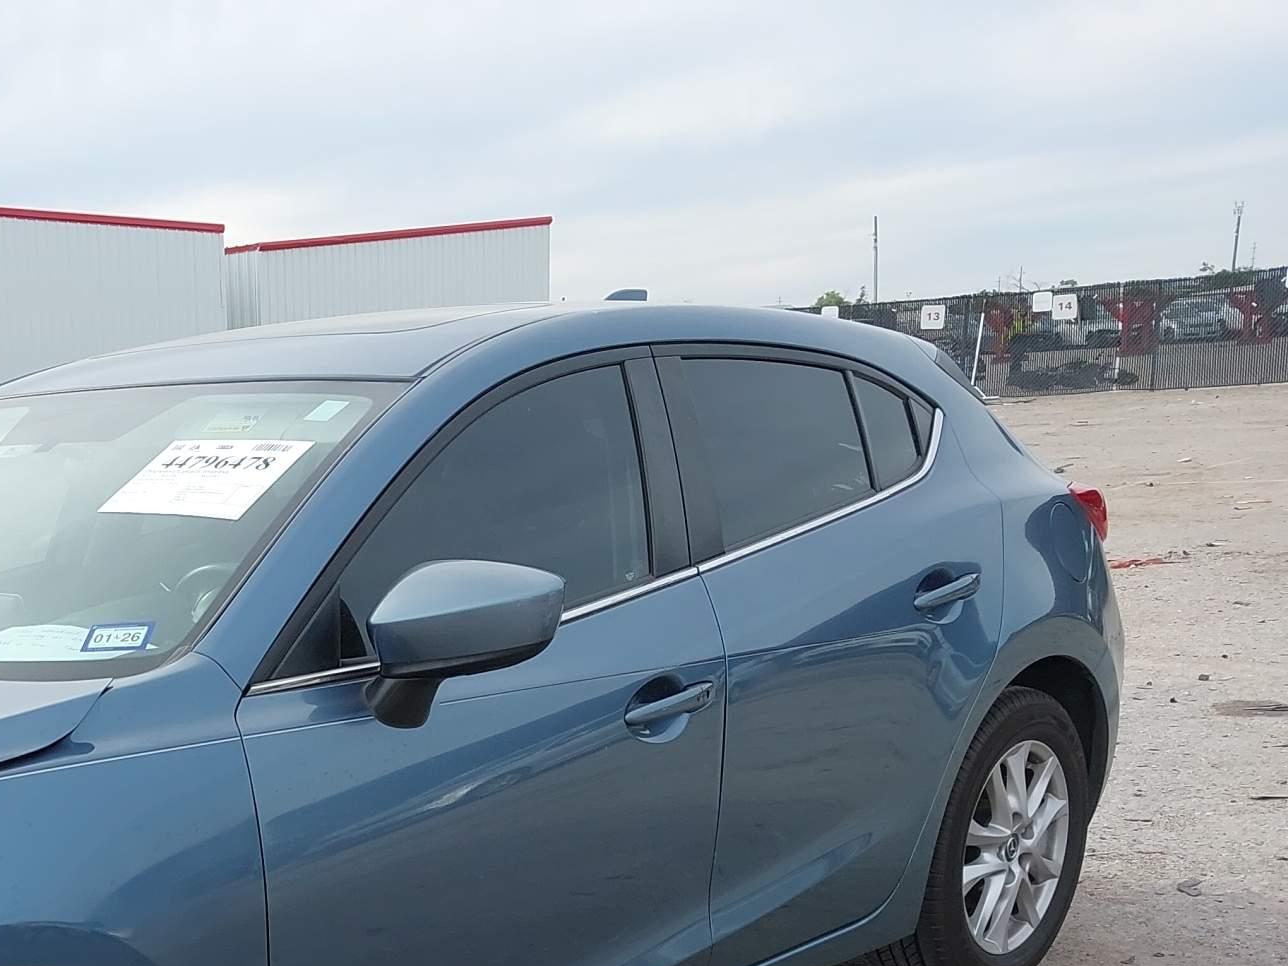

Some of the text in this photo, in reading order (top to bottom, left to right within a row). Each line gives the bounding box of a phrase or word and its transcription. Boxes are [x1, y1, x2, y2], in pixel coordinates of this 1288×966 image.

[1057, 302, 1073, 311] 14
[927, 312, 940, 321] 13
[161, 455, 277, 471] 44796478
